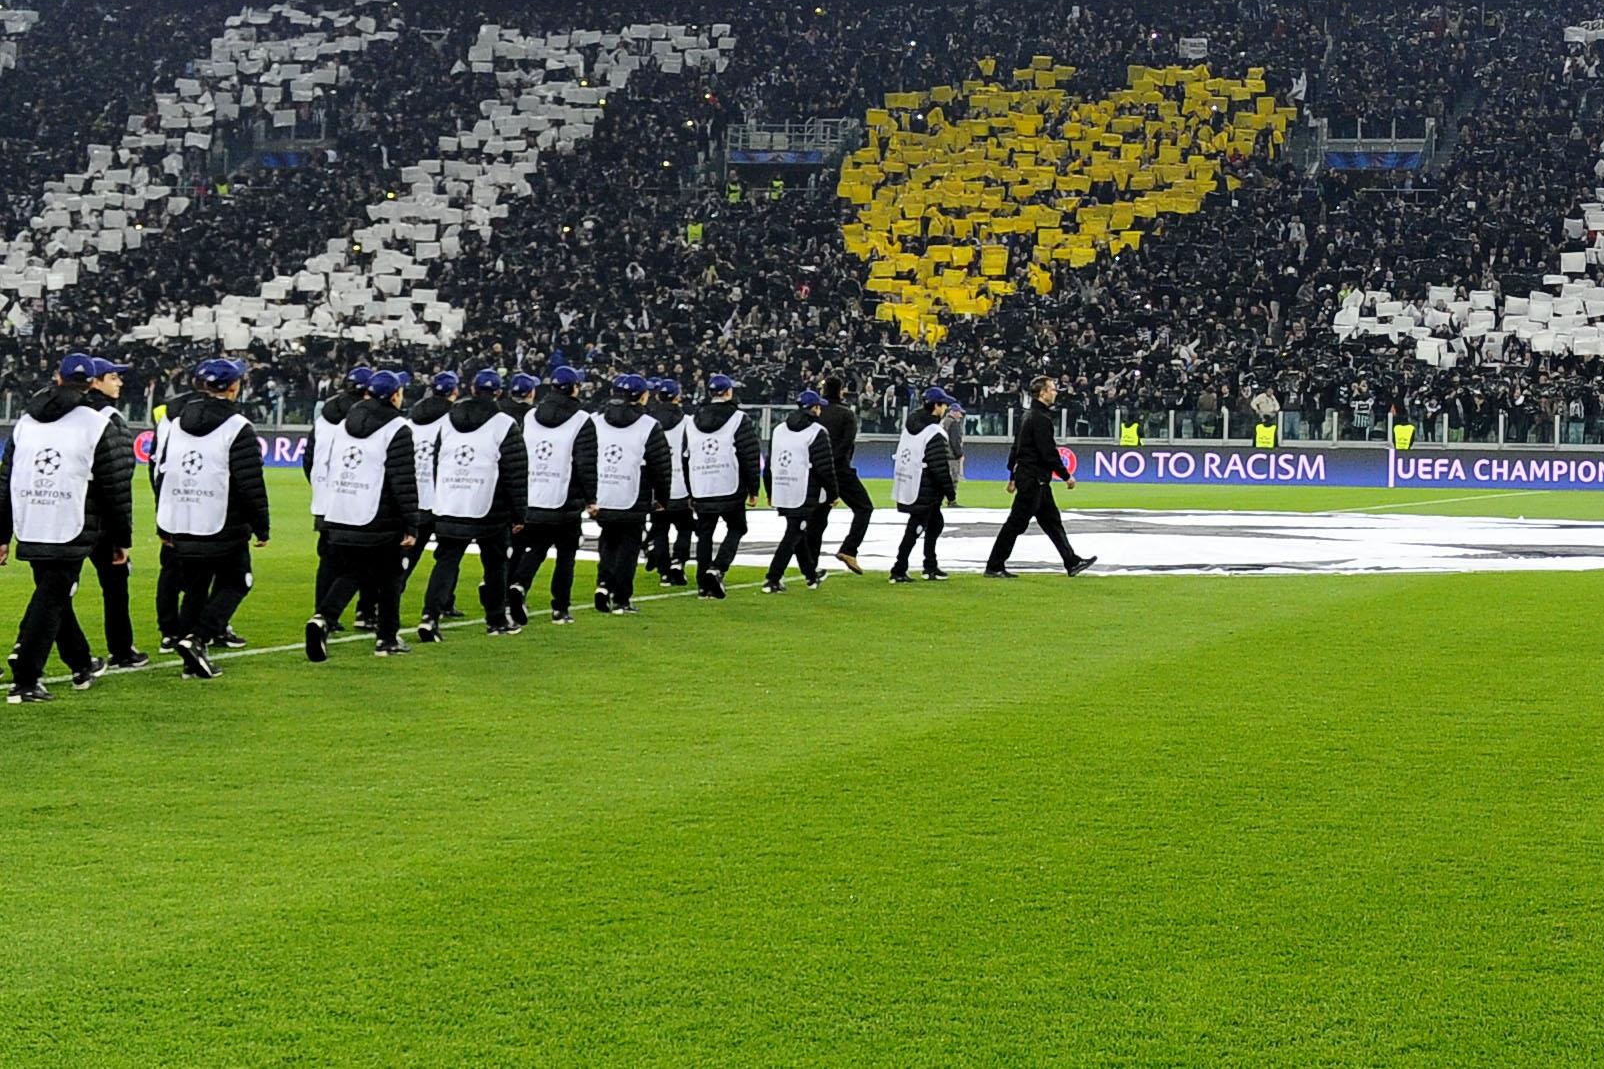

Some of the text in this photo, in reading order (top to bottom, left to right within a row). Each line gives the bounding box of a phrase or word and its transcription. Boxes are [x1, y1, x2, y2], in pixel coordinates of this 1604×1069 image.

[1095, 451, 1145, 478] NO
[1151, 452, 1195, 478] TO
[1204, 452, 1326, 480] RACISM
[1397, 458, 1466, 480] UEFA
